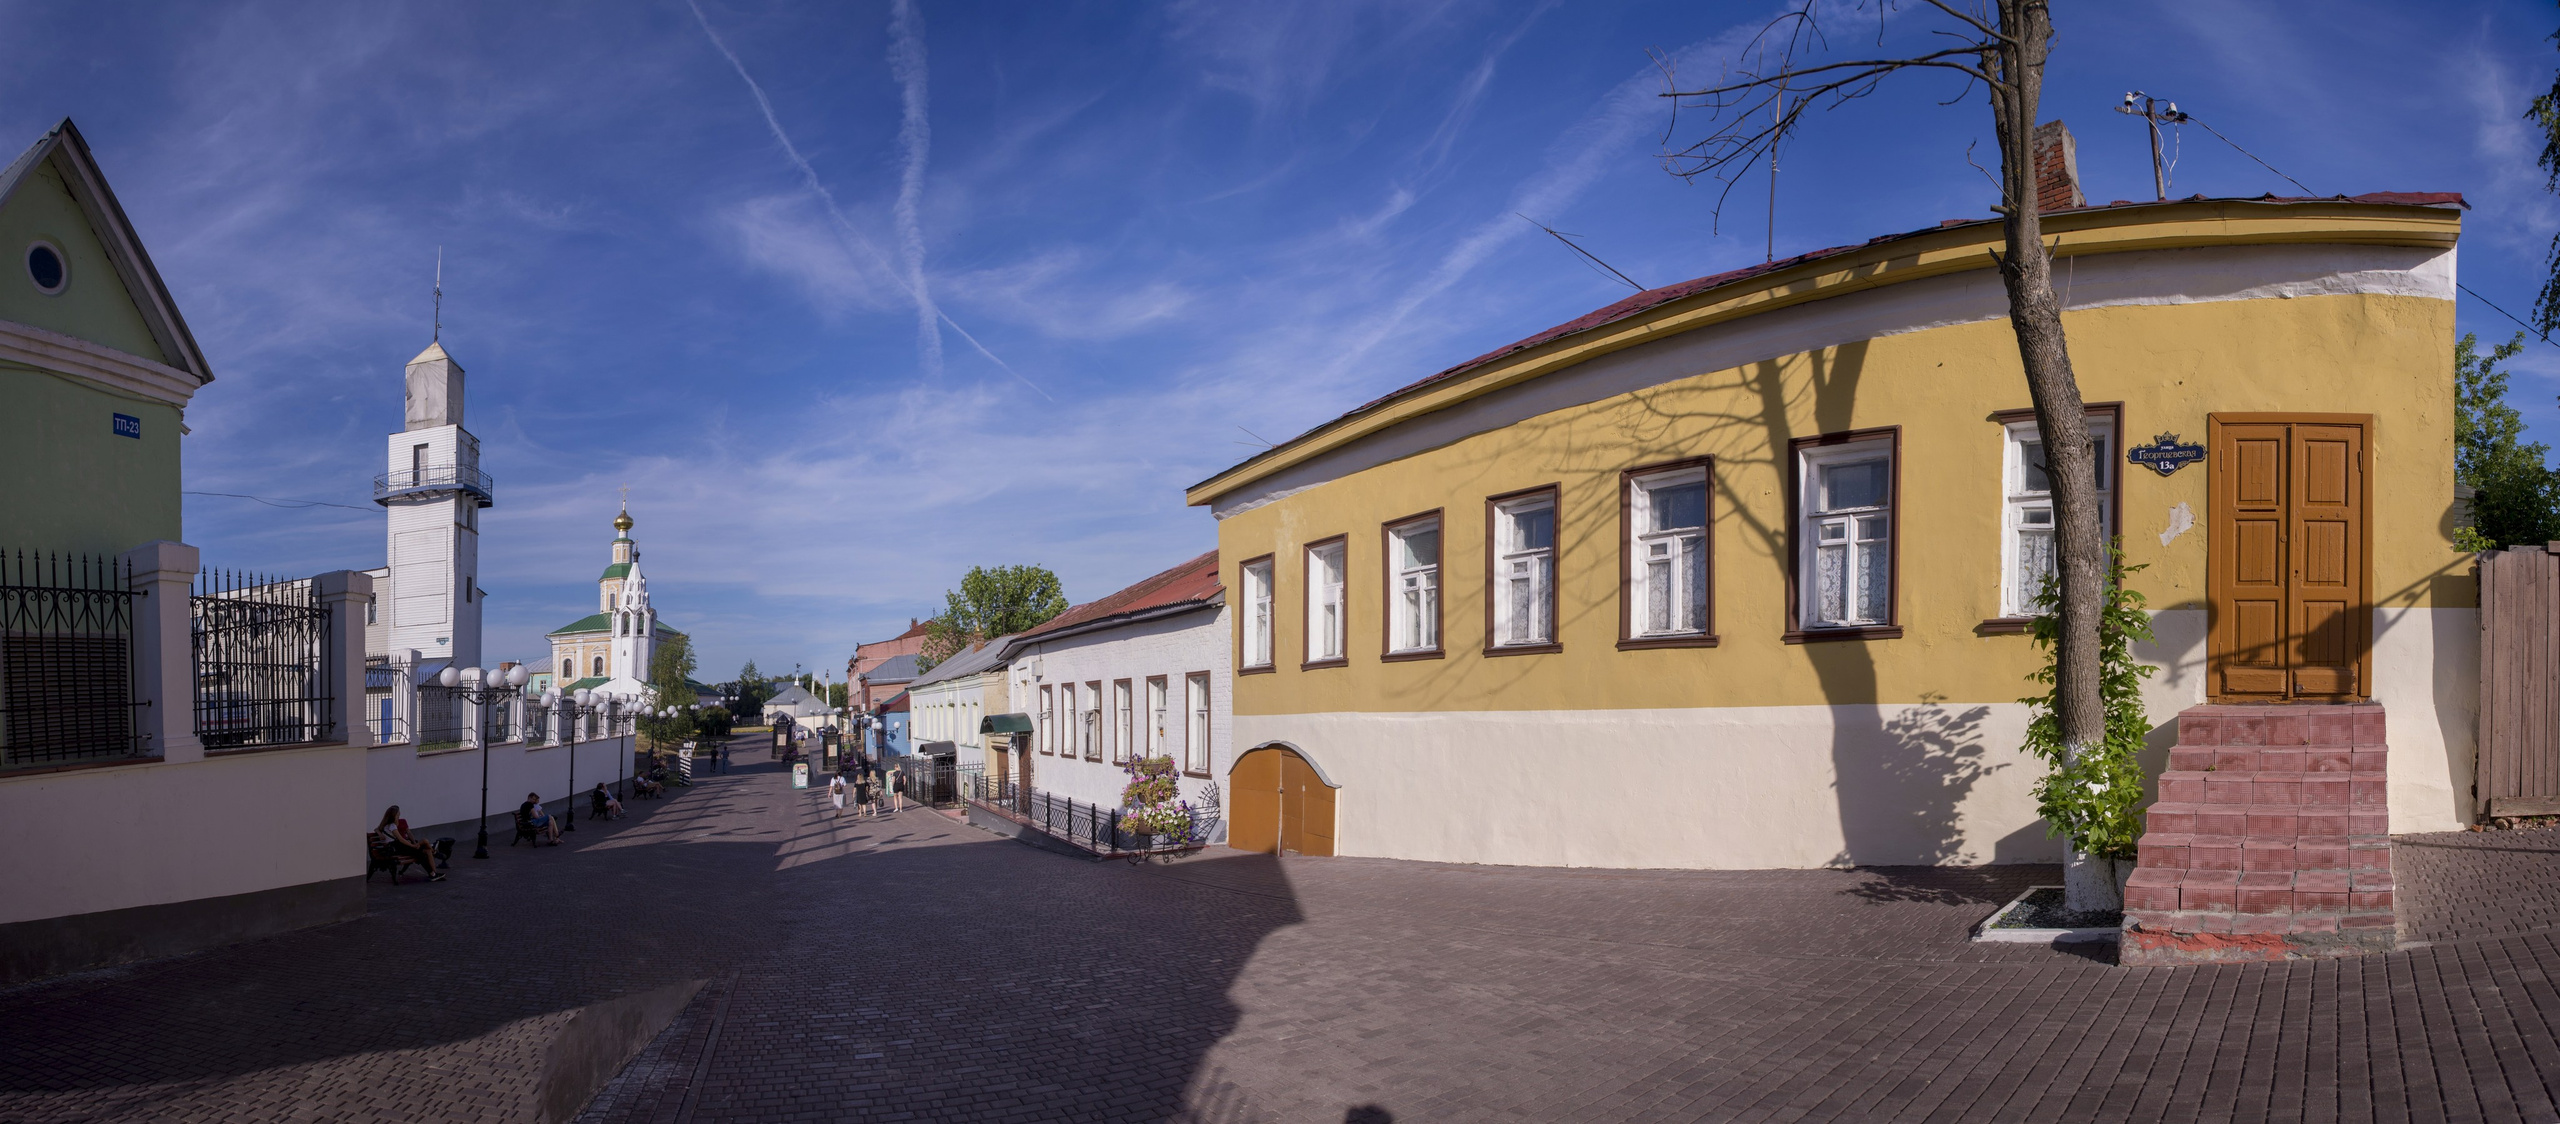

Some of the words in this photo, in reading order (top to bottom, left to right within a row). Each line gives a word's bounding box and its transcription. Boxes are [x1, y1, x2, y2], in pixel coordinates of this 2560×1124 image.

[115, 417, 139, 434] ТП-23
[2138, 450, 2197, 460] Георгиевская
[2160, 461, 2174, 469] 13а
